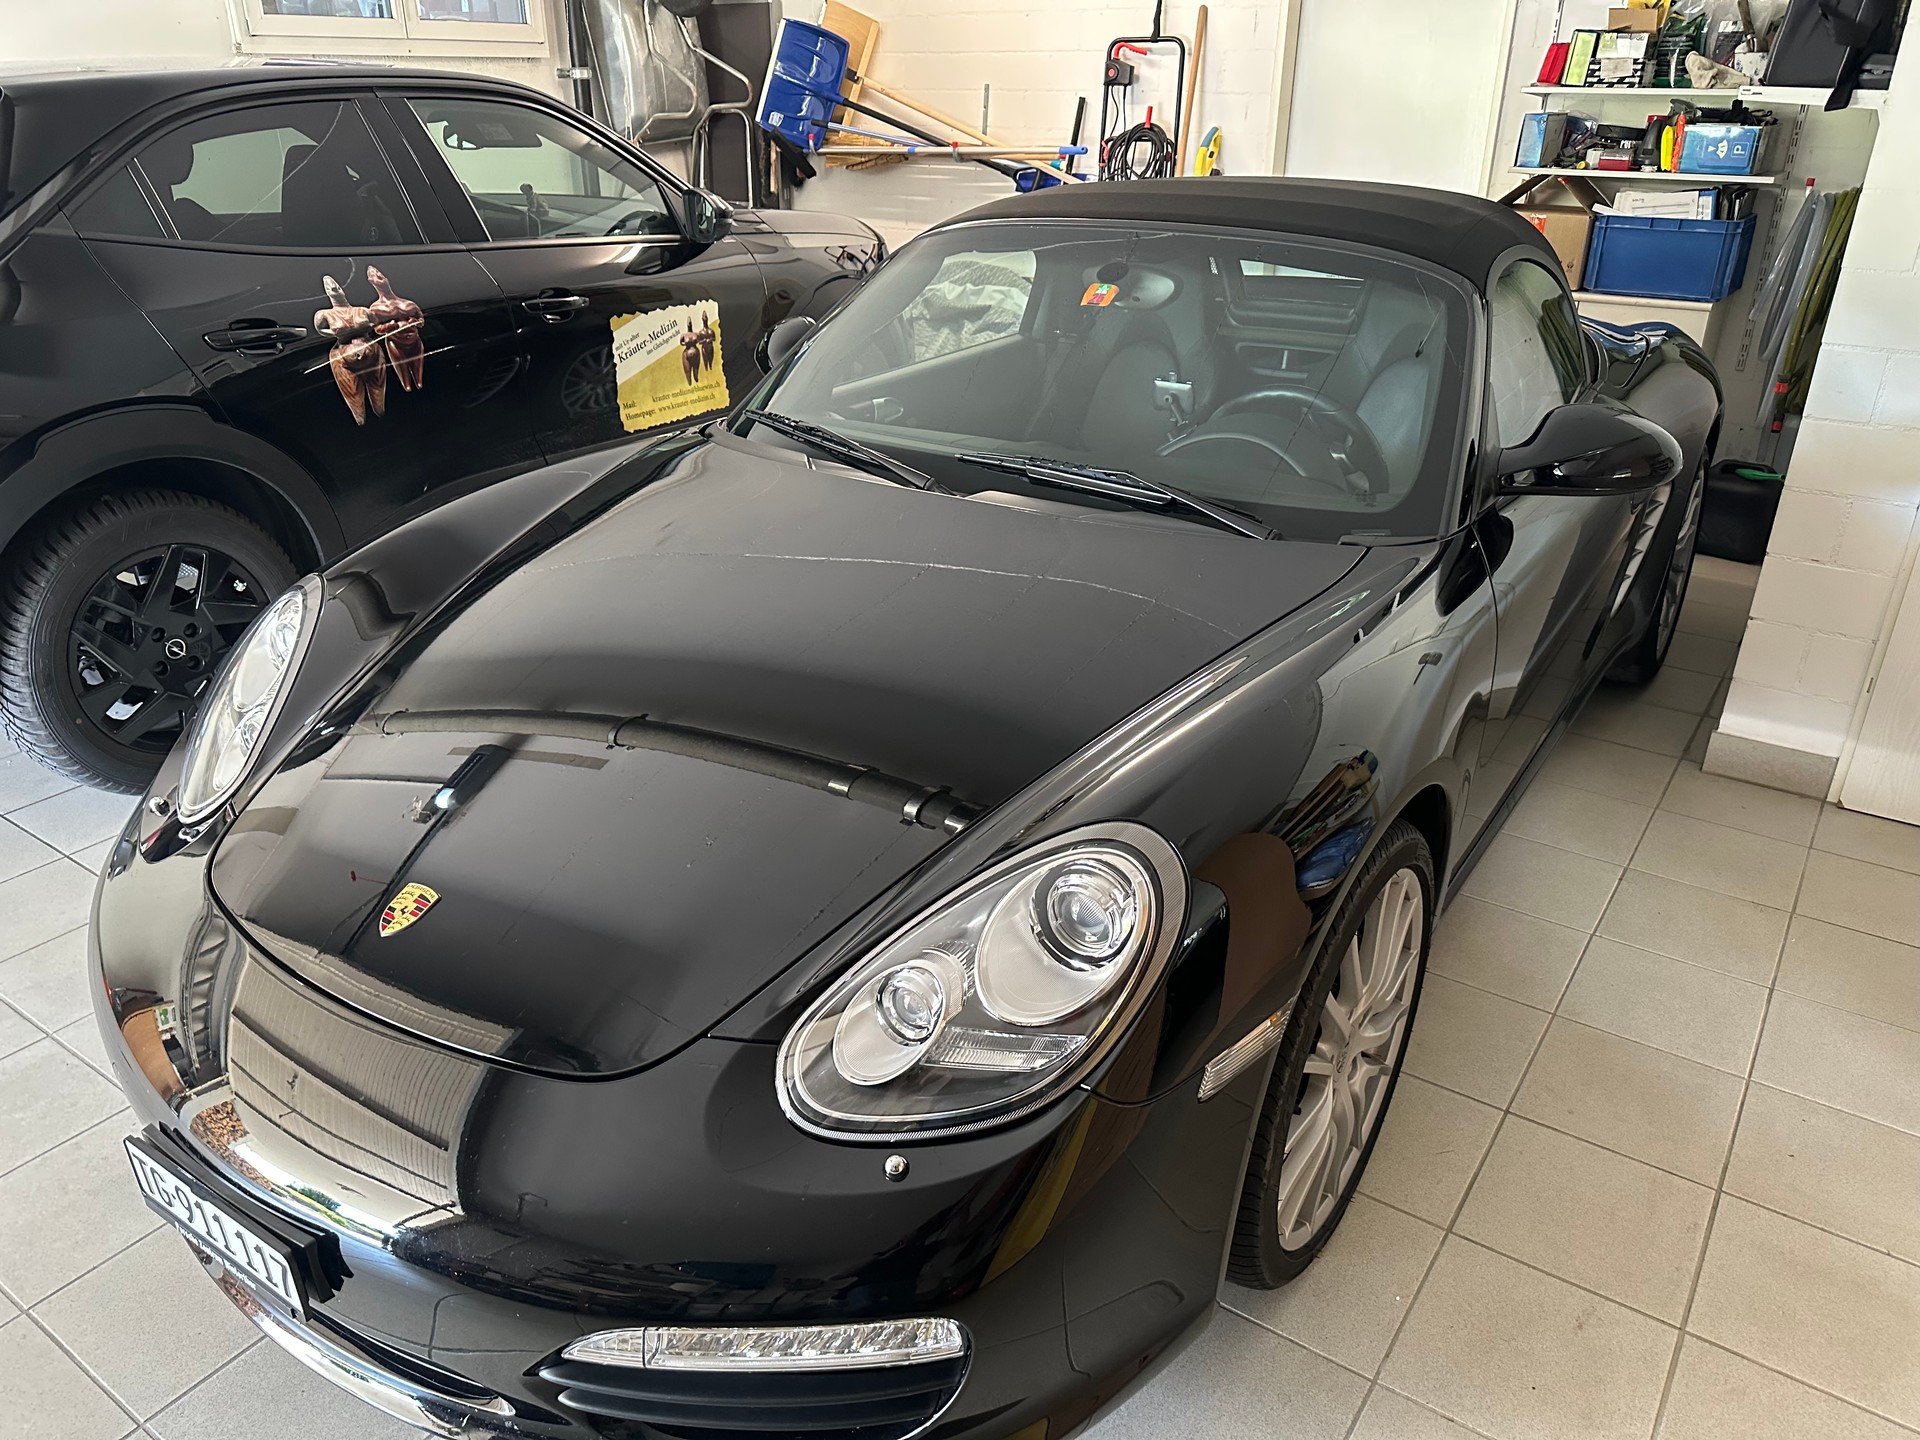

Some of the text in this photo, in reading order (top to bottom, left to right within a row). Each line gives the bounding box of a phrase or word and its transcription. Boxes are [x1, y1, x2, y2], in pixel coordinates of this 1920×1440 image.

[617, 318, 679, 364] Kräuter-Medizin
[653, 329, 681, 350] Gleichgewicht
[623, 400, 637, 410] Mail:
[625, 408, 656, 421] Homepage:
[407, 884, 435, 900] PORSCHE
